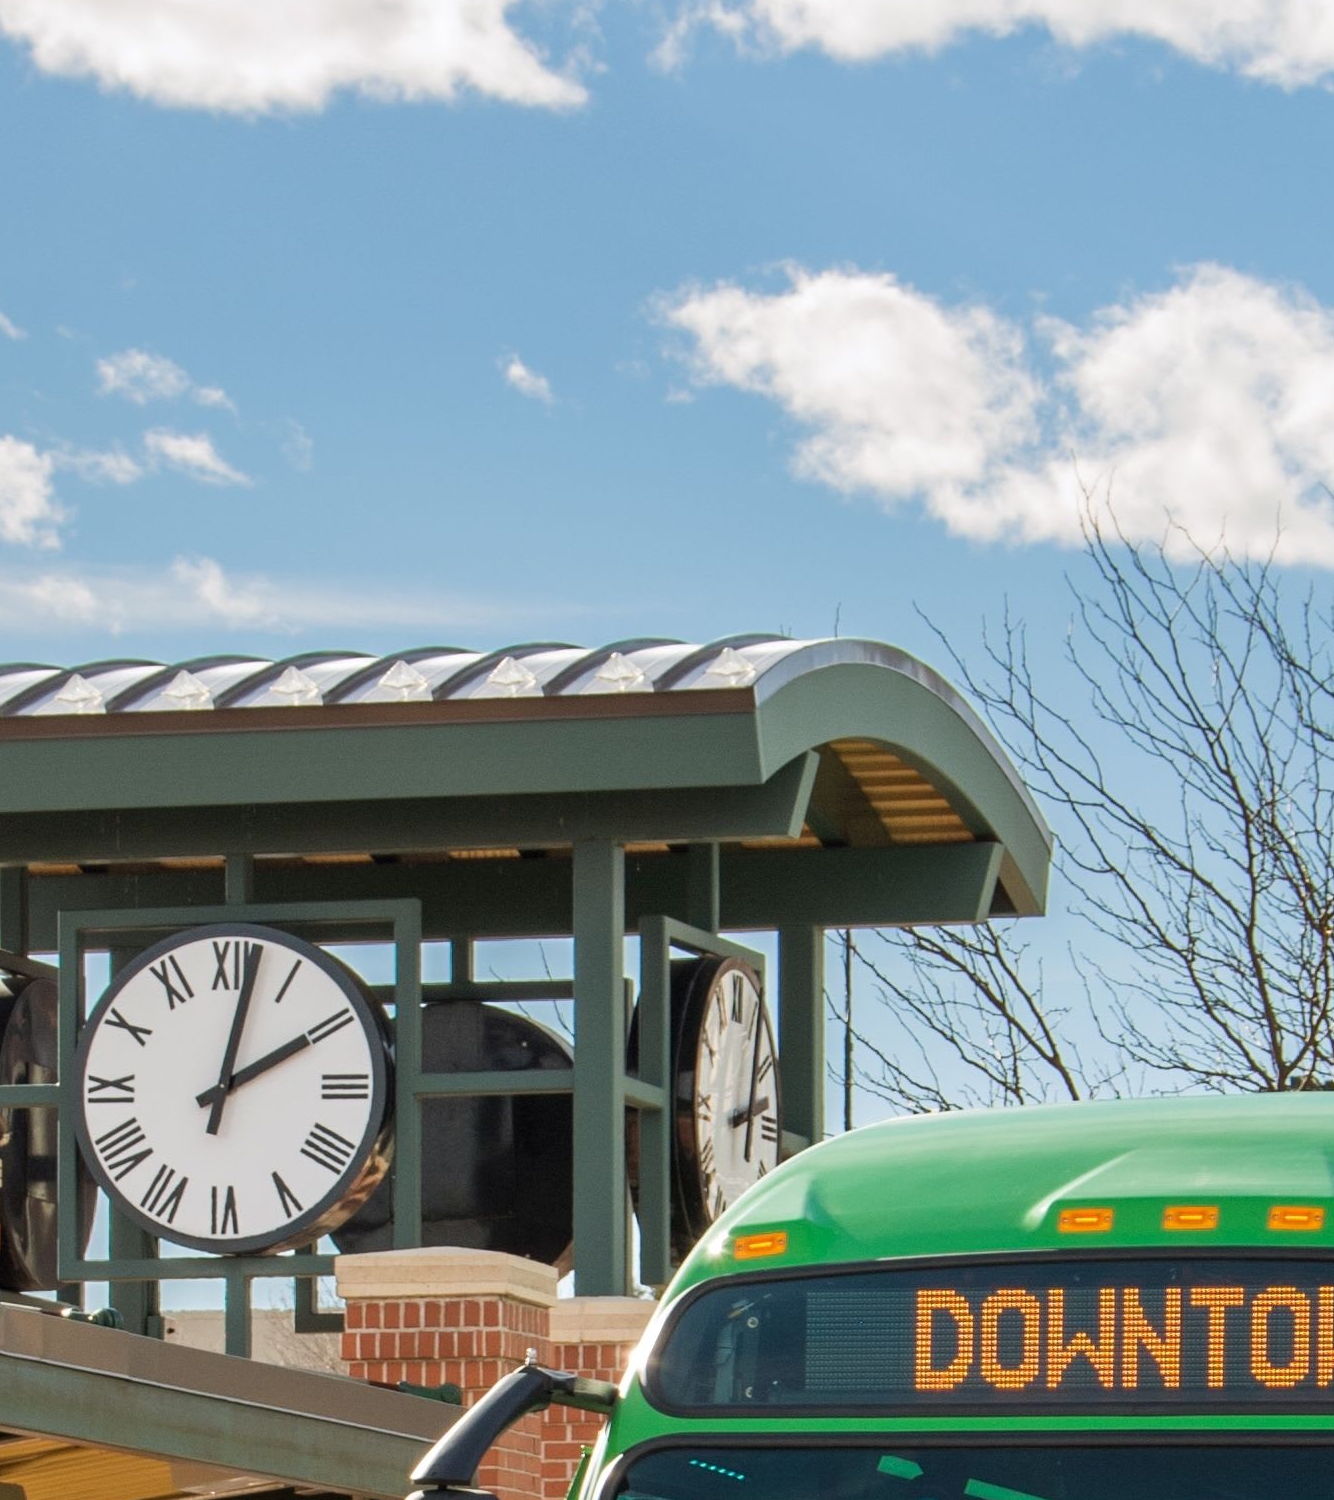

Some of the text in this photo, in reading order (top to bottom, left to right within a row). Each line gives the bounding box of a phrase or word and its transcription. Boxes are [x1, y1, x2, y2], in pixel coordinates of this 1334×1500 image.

[149, 954, 195, 1011] XI
[104, 1007, 153, 1047] X
[321, 1073, 369, 1100] III
